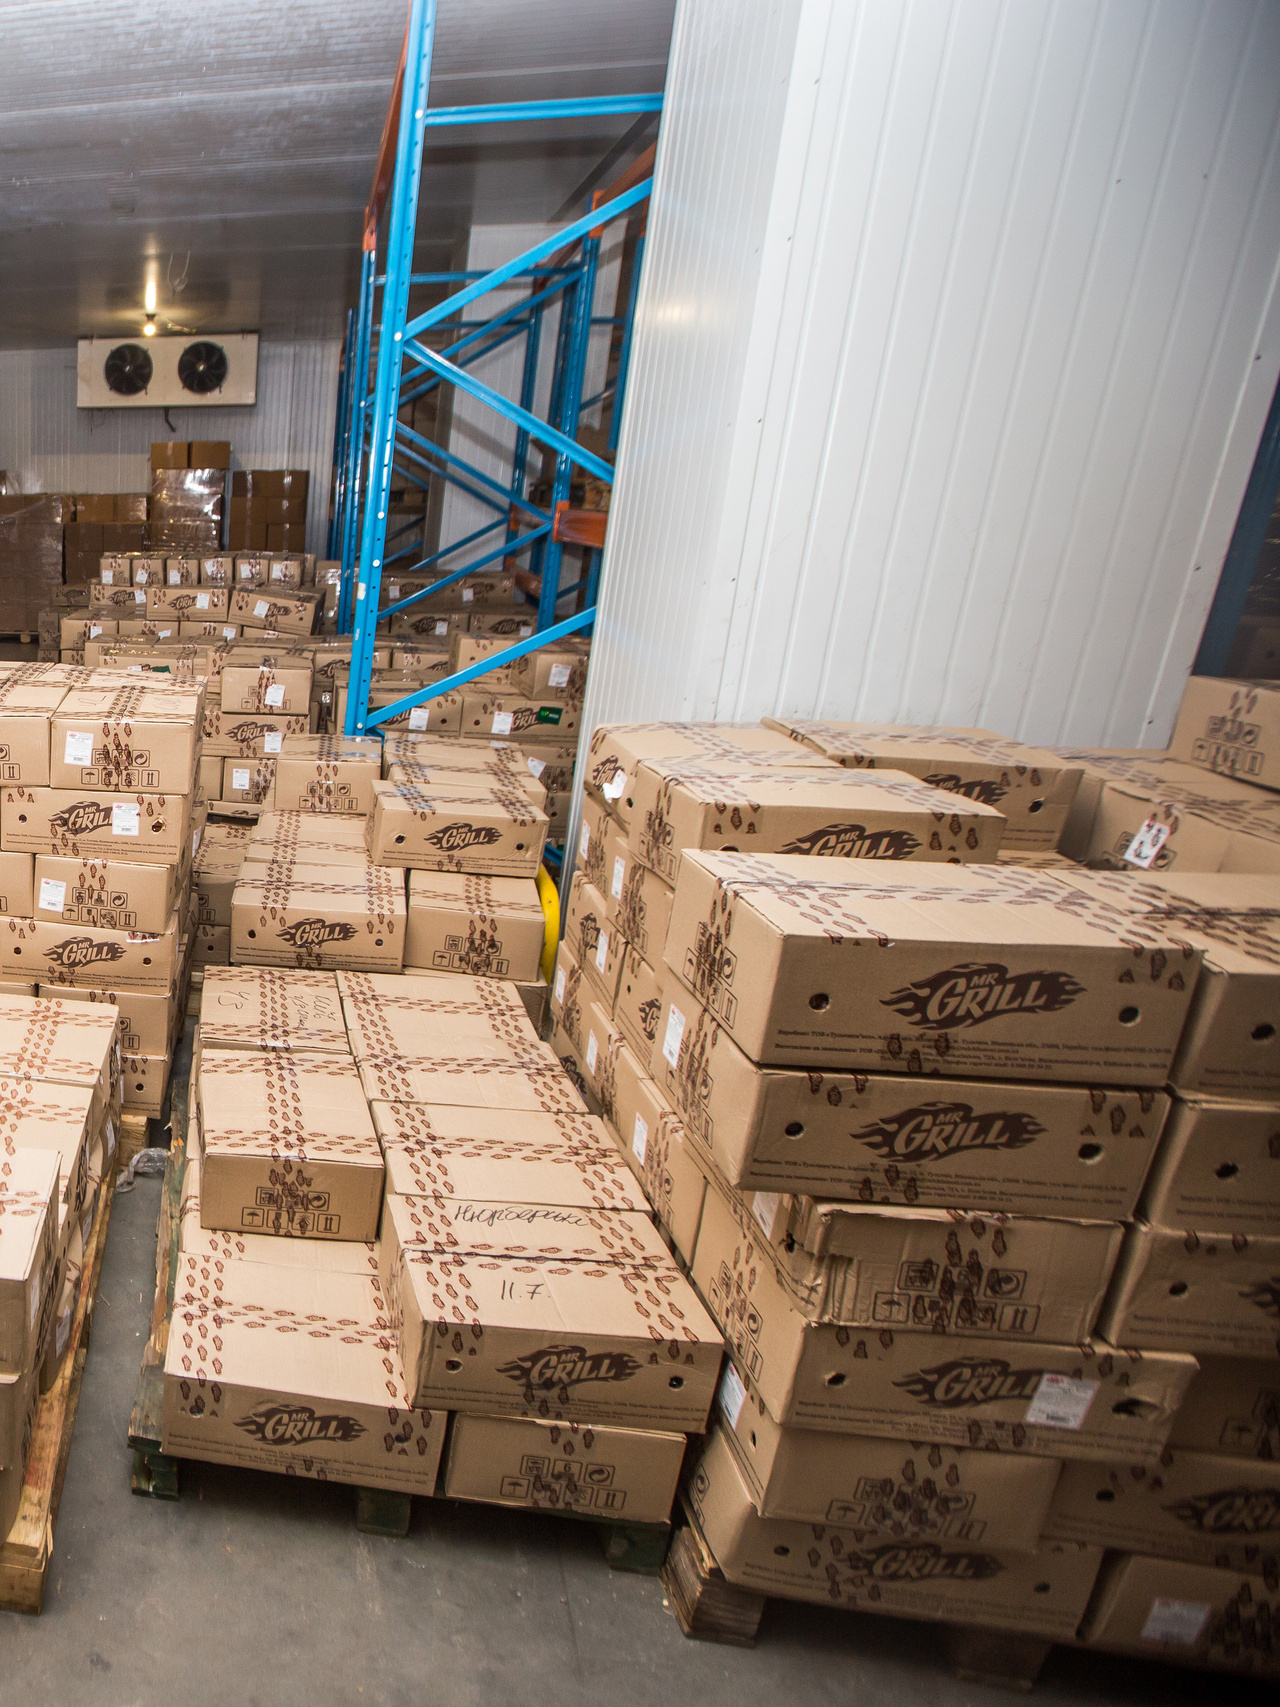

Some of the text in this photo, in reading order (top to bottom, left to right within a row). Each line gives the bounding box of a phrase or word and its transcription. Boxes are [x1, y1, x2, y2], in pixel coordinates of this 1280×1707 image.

[442, 828, 489, 848] GRILL
[839, 831, 859, 841] MR
[295, 924, 344, 945] GRILL
[62, 943, 112, 965] GRILL
[78, 941, 90, 949] MR
[970, 972, 999, 987] MR
[926, 977, 1048, 1021] GRILL
[935, 1112, 964, 1124] MR
[894, 1115, 1010, 1155] GRILL
[560, 1353, 580, 1362] MR
[530, 1355, 616, 1384] GRILL
[291, 1413, 309, 1421] MR
[264, 1413, 342, 1442] GRILL
